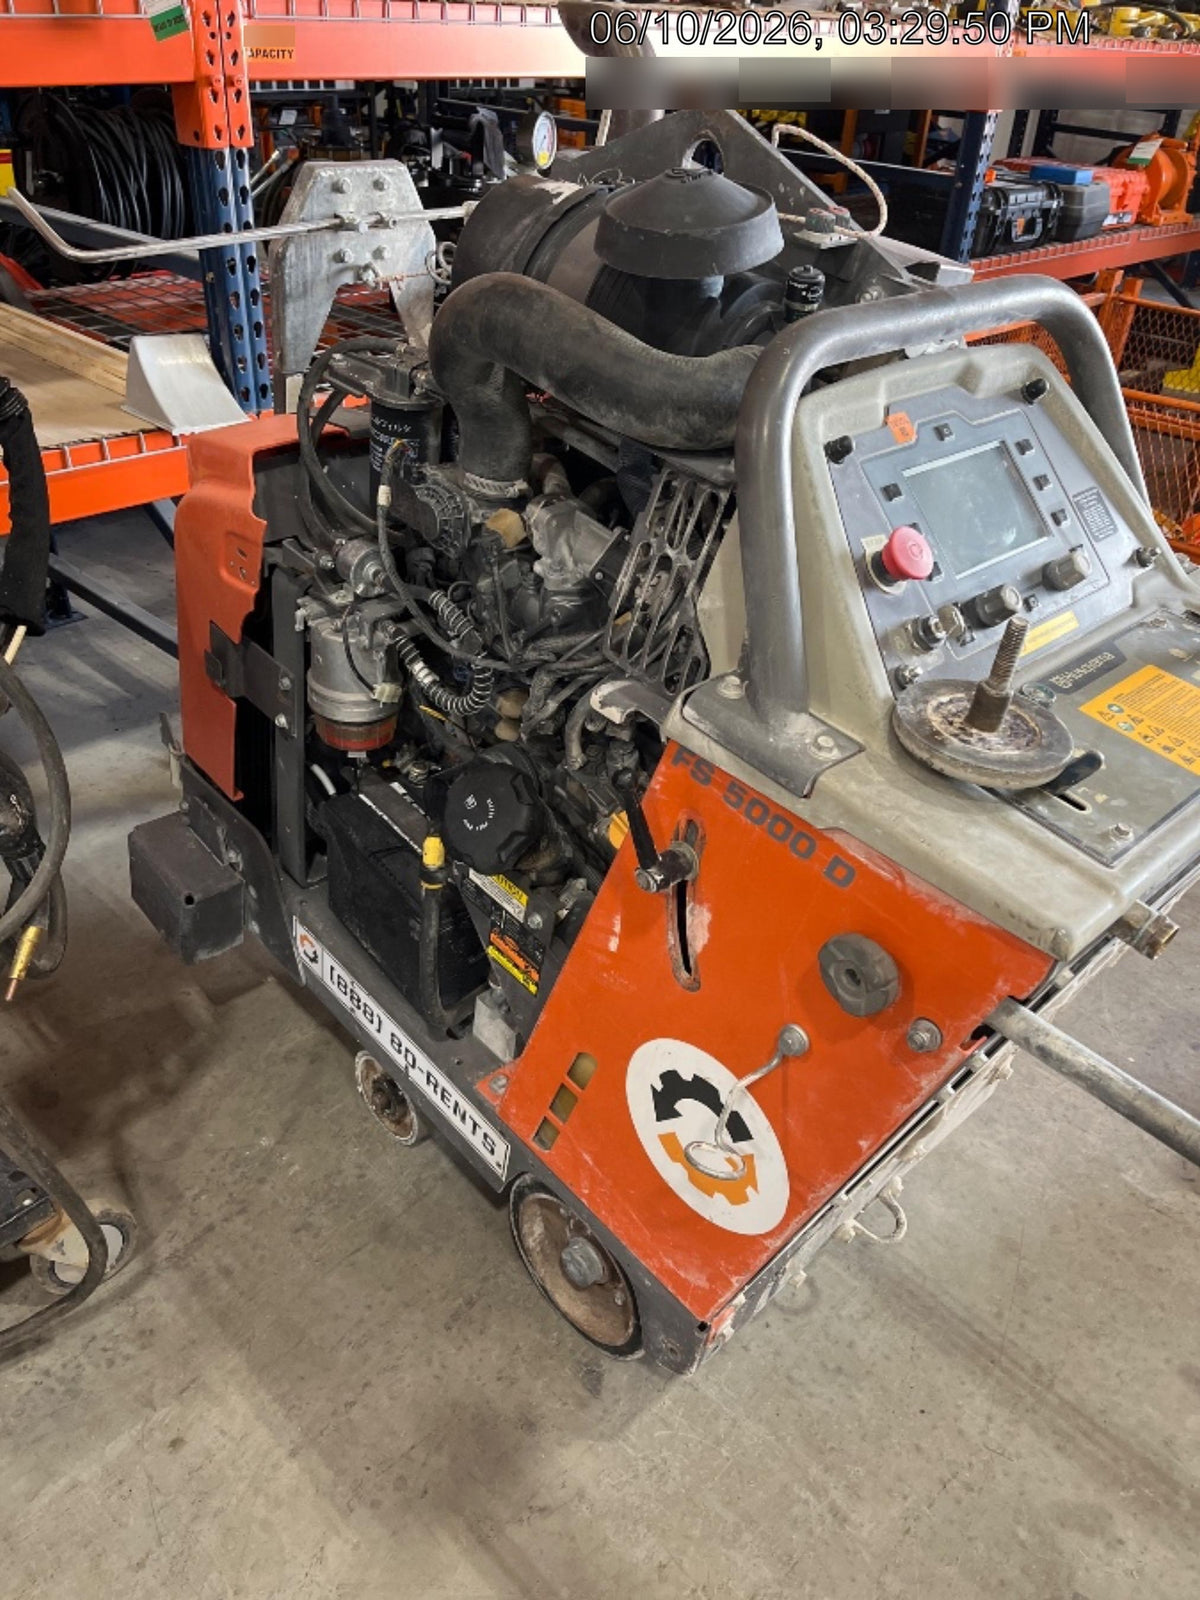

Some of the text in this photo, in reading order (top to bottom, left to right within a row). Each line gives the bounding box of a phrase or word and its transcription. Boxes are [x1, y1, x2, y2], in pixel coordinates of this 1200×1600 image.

[248, 47, 294, 59] APACITY
[670, 746, 857, 889] FS 5000 D
[329, 964, 498, 1156] (888) 80-RENTS
